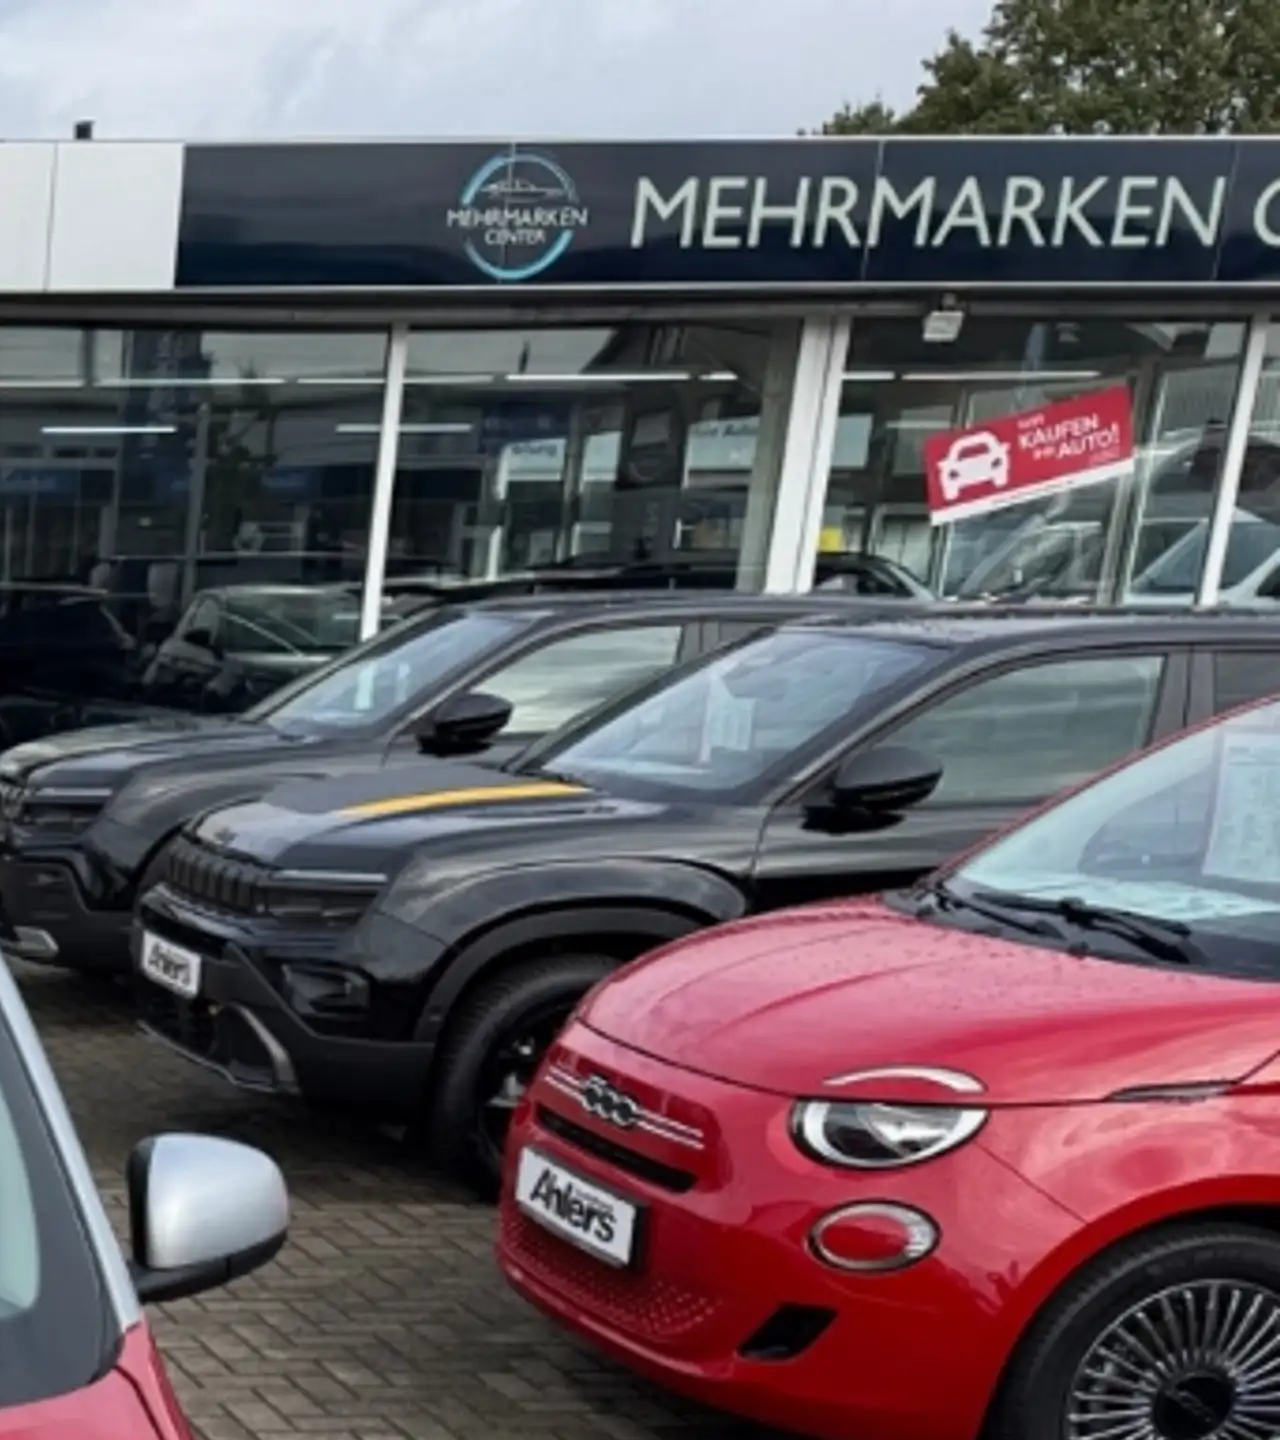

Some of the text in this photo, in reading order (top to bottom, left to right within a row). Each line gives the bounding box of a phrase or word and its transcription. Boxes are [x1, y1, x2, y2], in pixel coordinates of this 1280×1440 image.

[446, 207, 589, 228] MEHRMARKEN
[631, 176, 1225, 246] MEHRMARKEN
[484, 229, 547, 246] CENTER
[1018, 412, 1100, 449] KAUFEN
[1058, 421, 1120, 459] AUTO!
[530, 1169, 617, 1243] Ahlers
